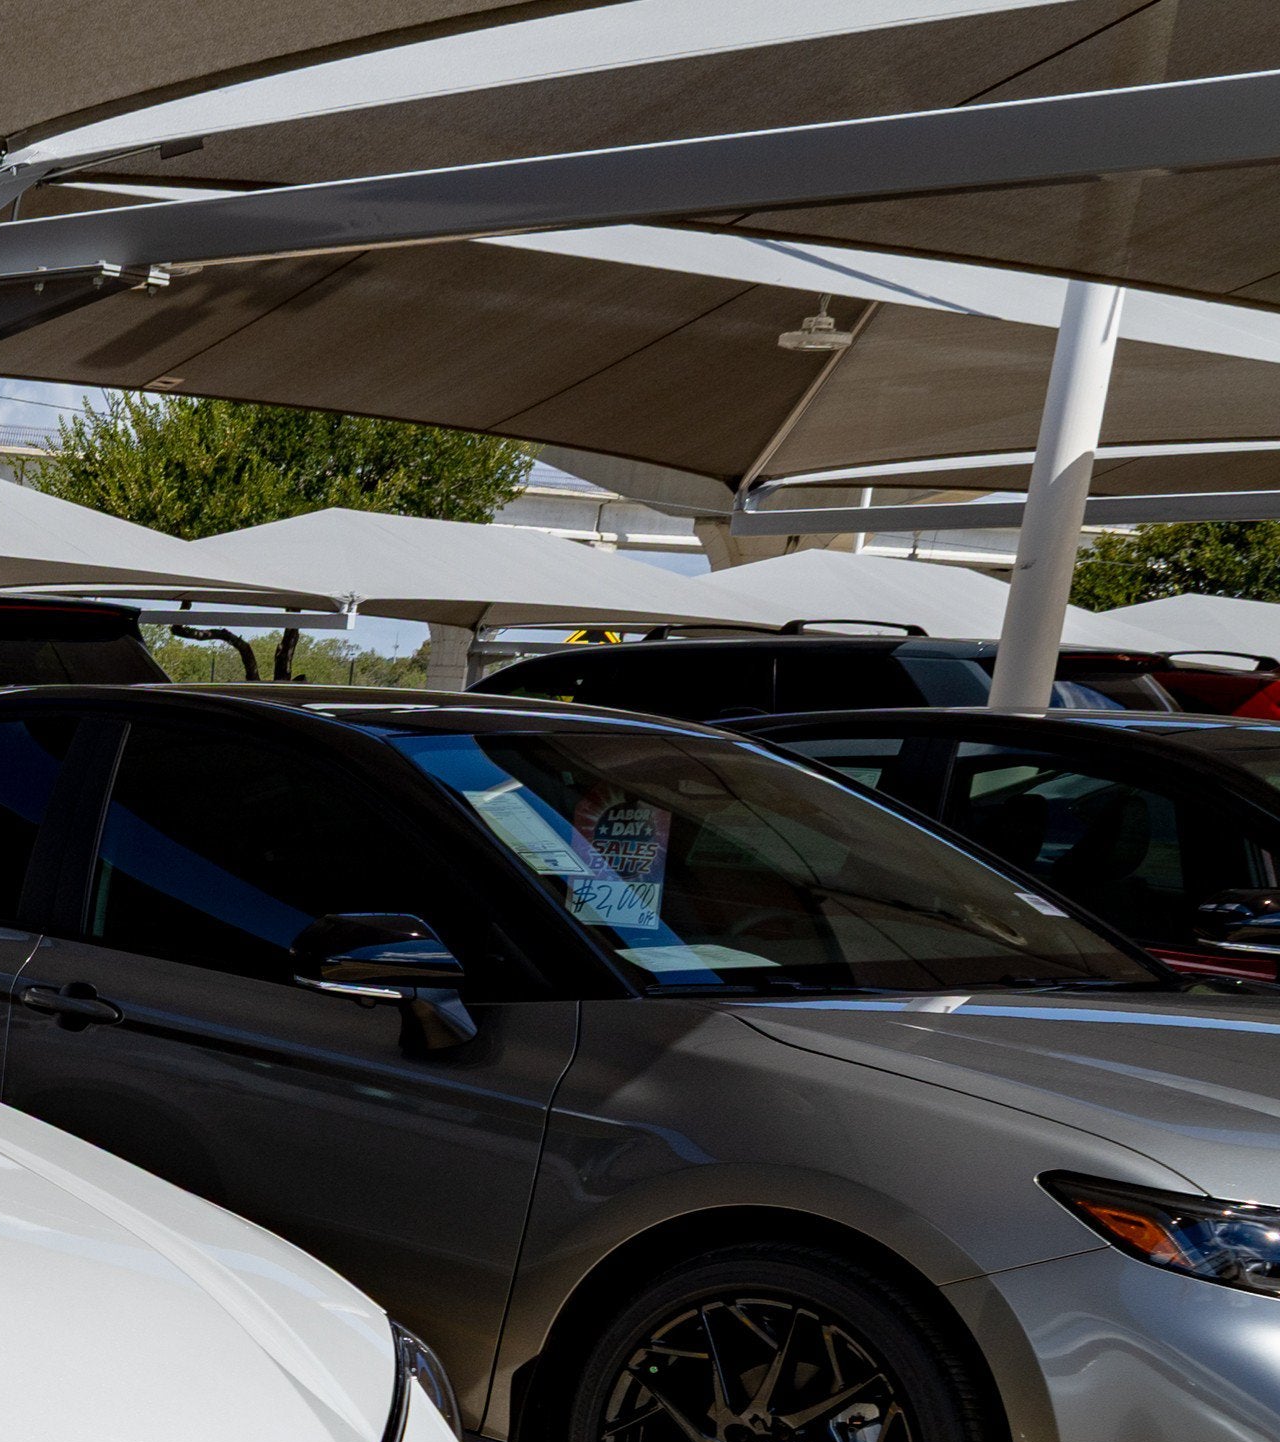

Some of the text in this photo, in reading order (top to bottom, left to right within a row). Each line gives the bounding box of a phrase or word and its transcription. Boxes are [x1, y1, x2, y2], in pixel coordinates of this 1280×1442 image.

[608, 808, 652, 821] LABOR
[611, 822, 645, 837] DAY
[591, 839, 659, 858] SALES
[589, 855, 652, 874] BLITZ
[572, 878, 656, 918] $2,000
